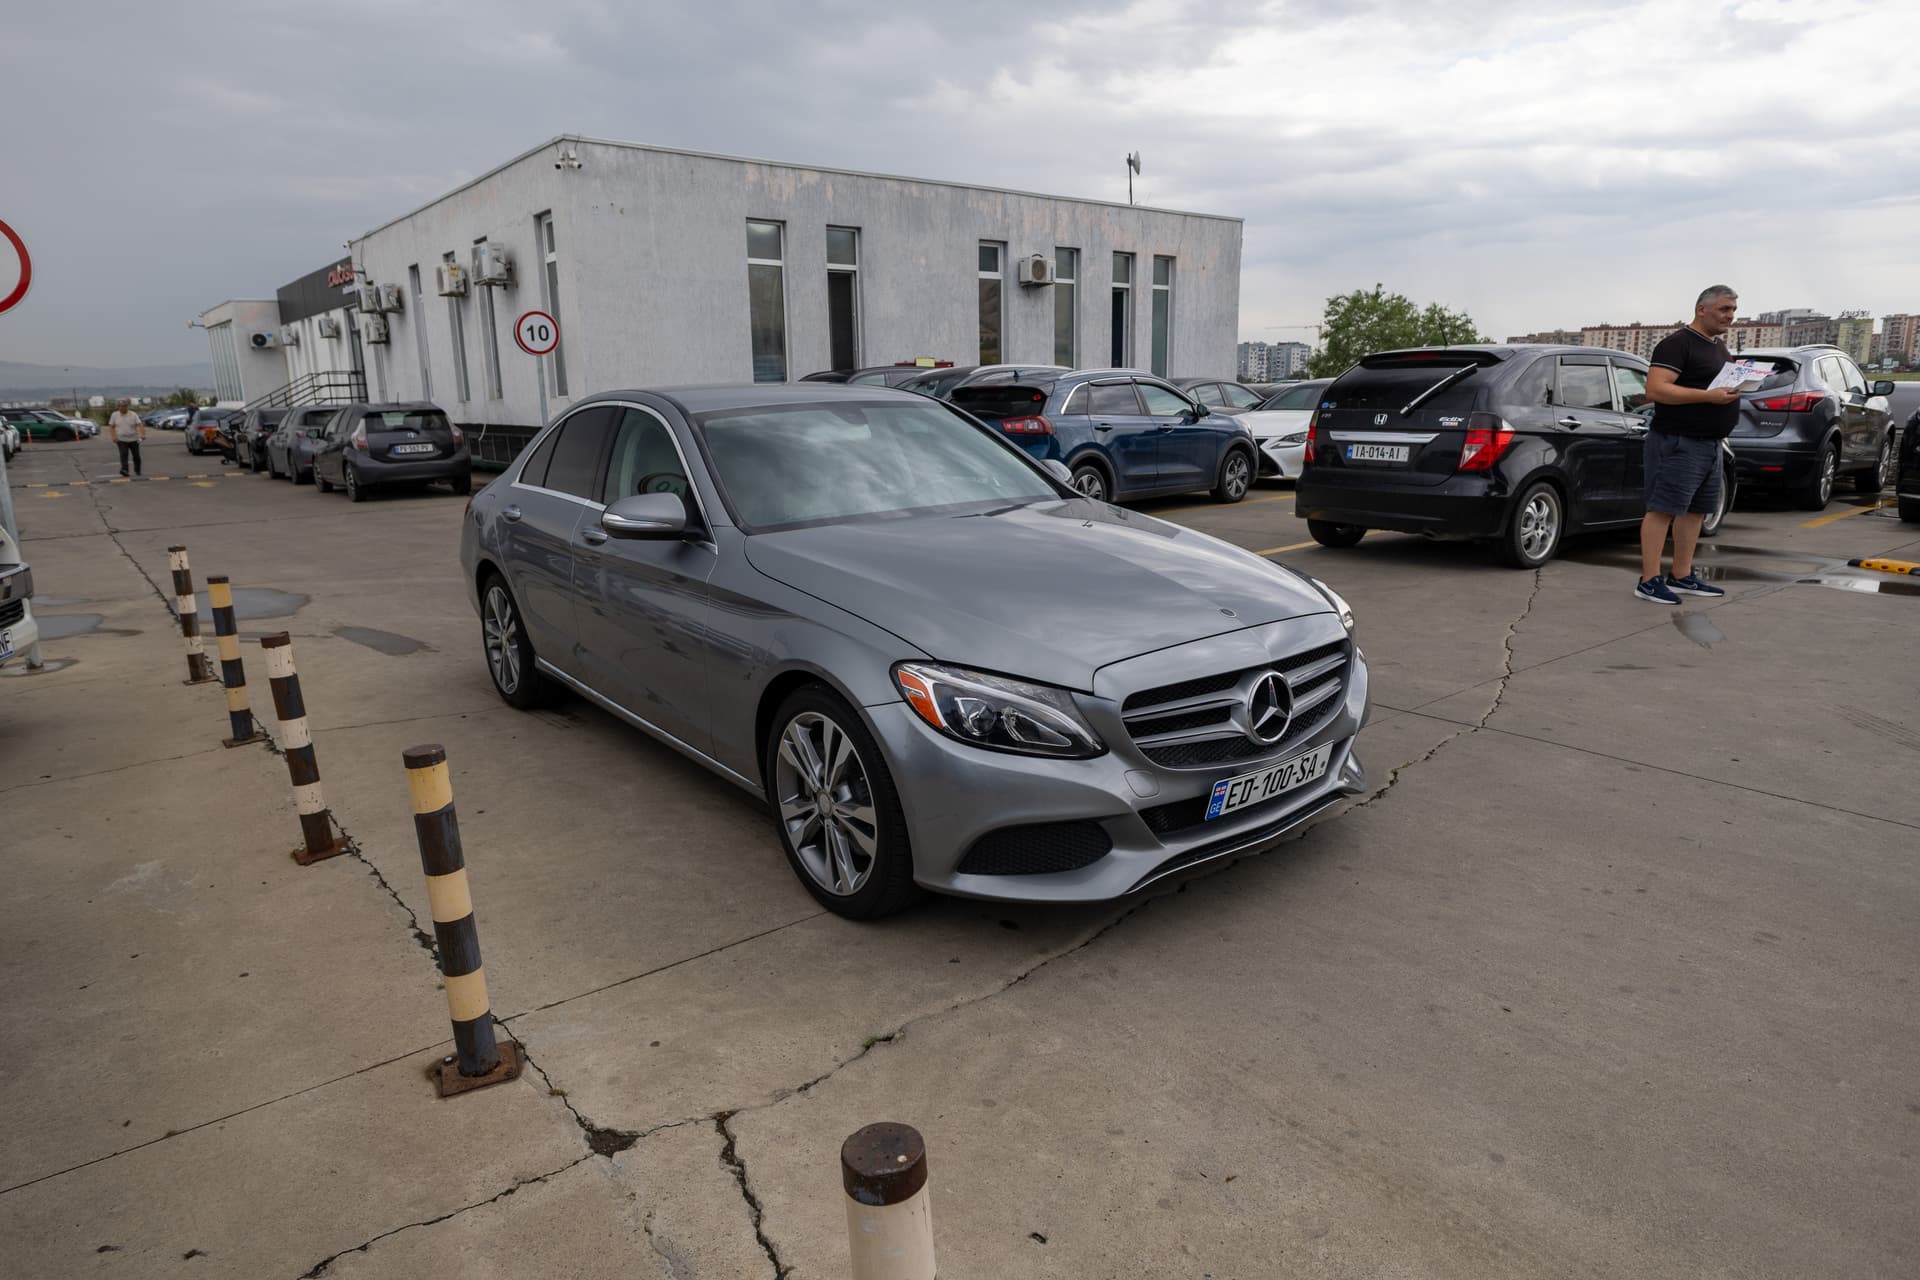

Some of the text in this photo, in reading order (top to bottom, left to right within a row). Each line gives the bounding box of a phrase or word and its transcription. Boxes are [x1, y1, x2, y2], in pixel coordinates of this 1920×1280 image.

[526, 325, 549, 342] 10
[1355, 446, 1400, 460] IA-014-AI
[1225, 753, 1319, 809] ED-100-SA
[1209, 802, 1222, 814] GE
